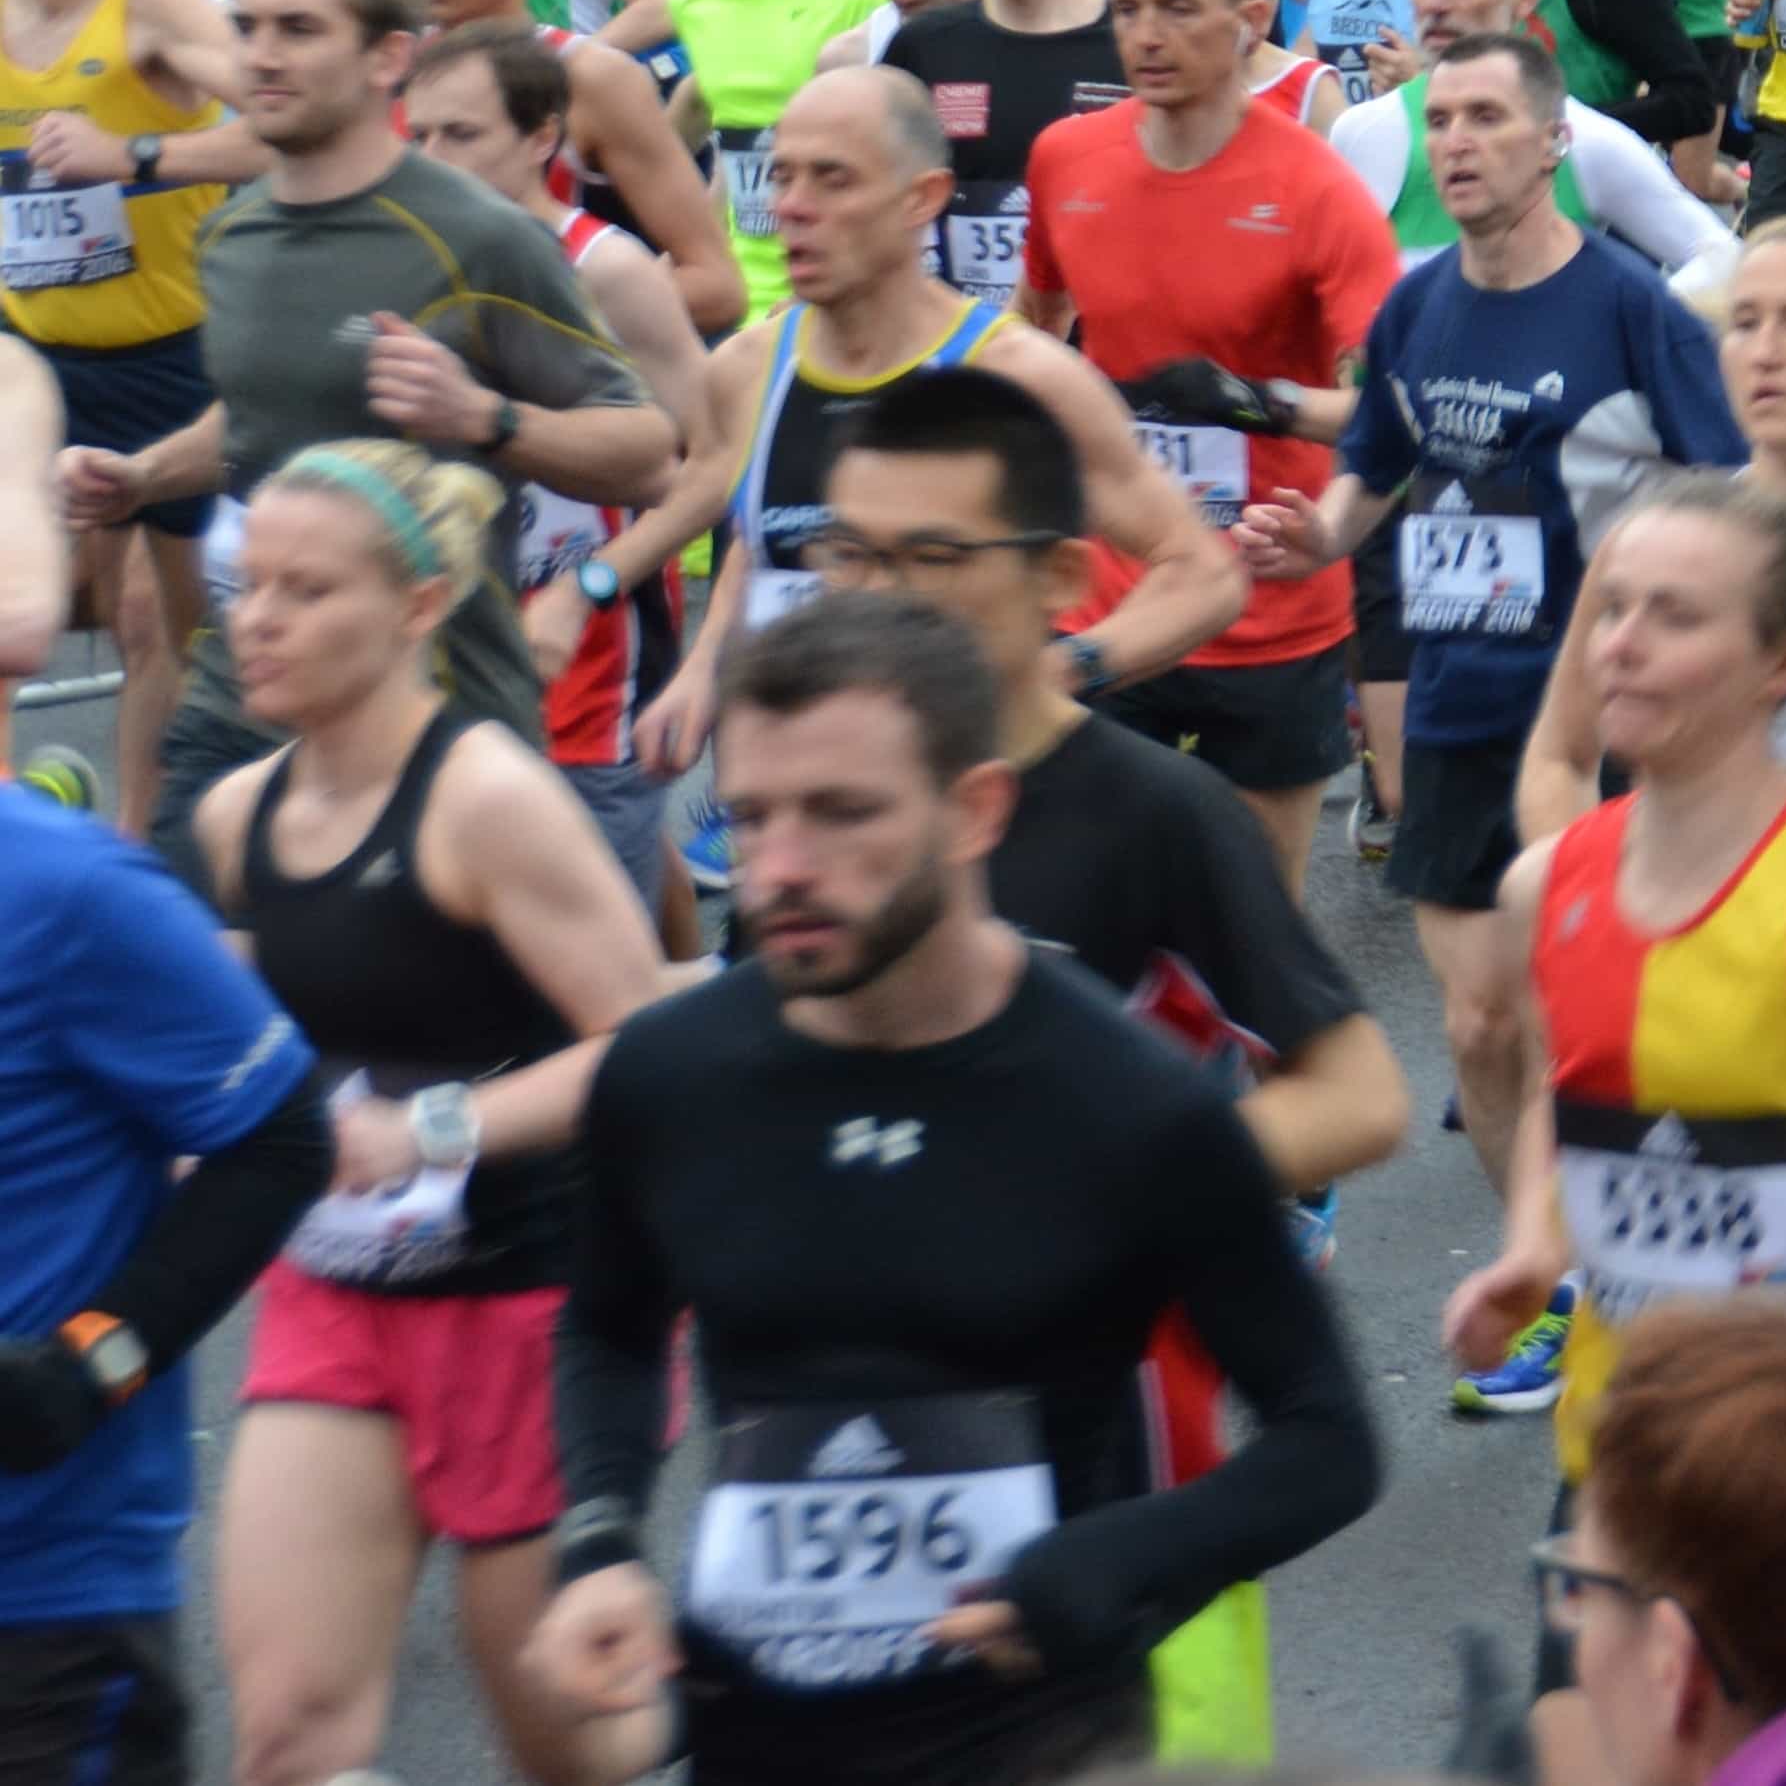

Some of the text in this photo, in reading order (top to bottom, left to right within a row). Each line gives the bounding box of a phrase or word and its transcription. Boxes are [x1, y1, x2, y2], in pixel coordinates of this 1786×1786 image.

[14, 198, 84, 240] 1015
[1411, 519, 1504, 571] 1573
[1484, 598, 1536, 633] 2016
[751, 1488, 976, 1583] 1596
